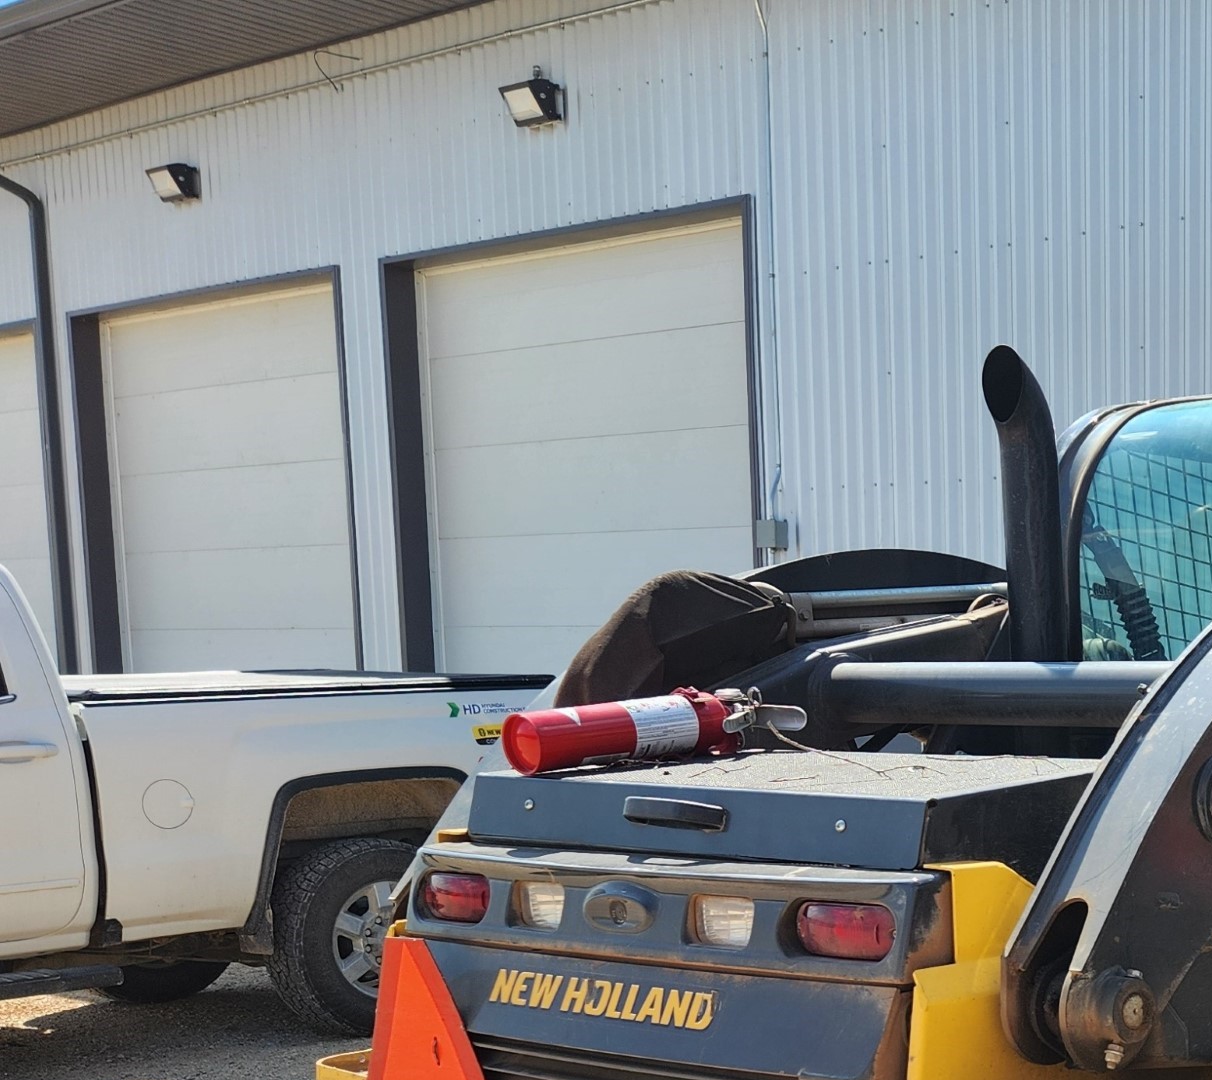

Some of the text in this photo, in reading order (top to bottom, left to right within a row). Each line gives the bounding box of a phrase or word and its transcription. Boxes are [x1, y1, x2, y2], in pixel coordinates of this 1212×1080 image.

[463, 703, 481, 715] HD
[489, 968, 717, 1030] NEW HOLLAND
